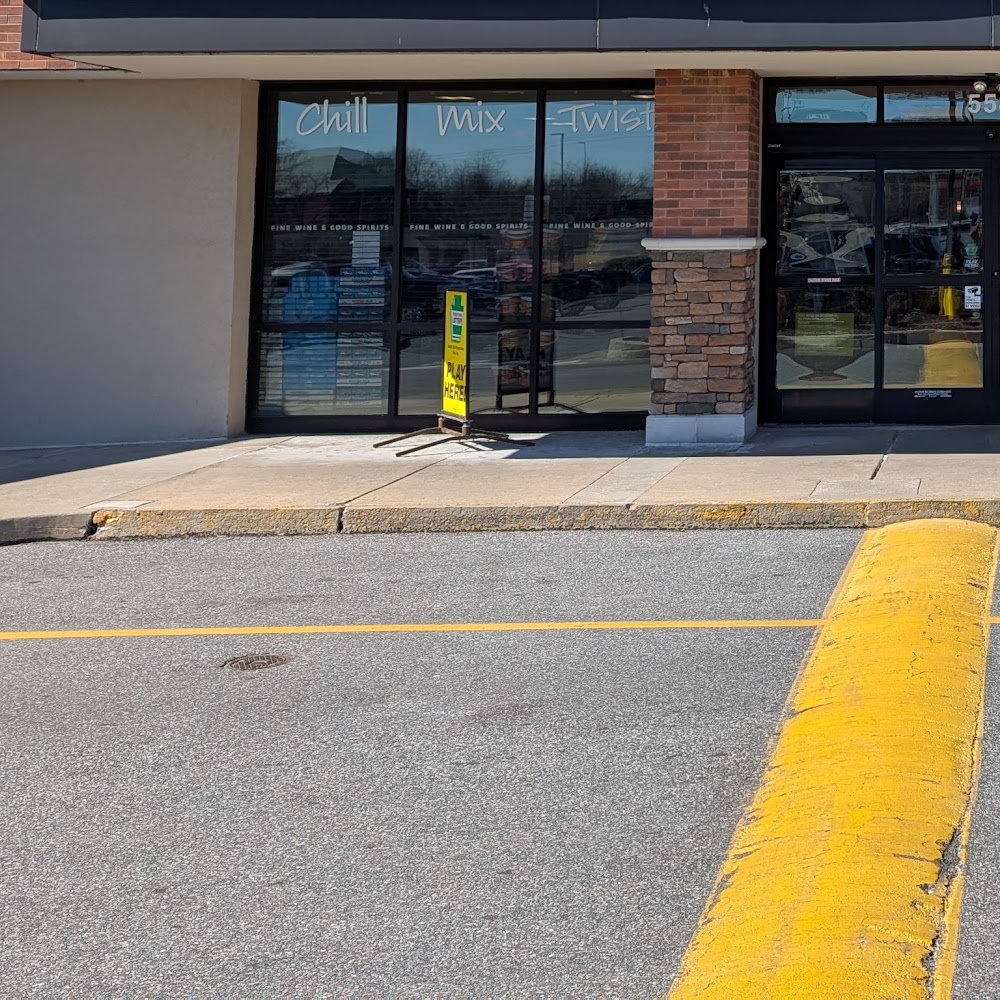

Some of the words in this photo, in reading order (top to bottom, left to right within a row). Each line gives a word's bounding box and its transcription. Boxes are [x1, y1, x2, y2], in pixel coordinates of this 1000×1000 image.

[296, 96, 369, 137] Chill
[436, 100, 507, 137] Mix
[557, 99, 657, 133] Twist
[495, 222, 529, 230] SPIRITS
[446, 361, 466, 382] PLAY
